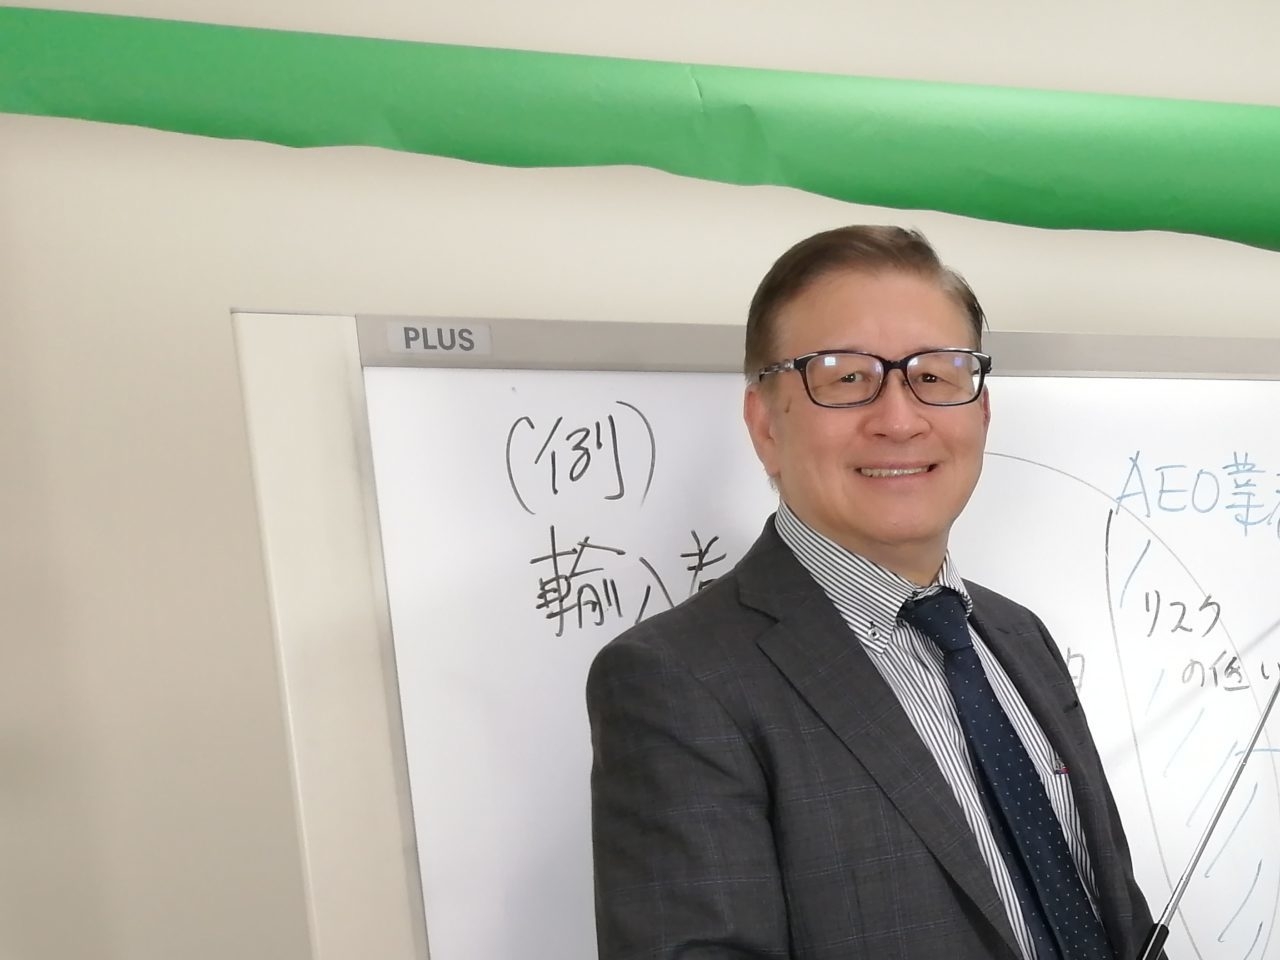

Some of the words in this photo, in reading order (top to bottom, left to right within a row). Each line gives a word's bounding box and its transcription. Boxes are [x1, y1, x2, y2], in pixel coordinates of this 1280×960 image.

[403, 325, 475, 352] PLUS
[1143, 588, 1222, 638] リスク
